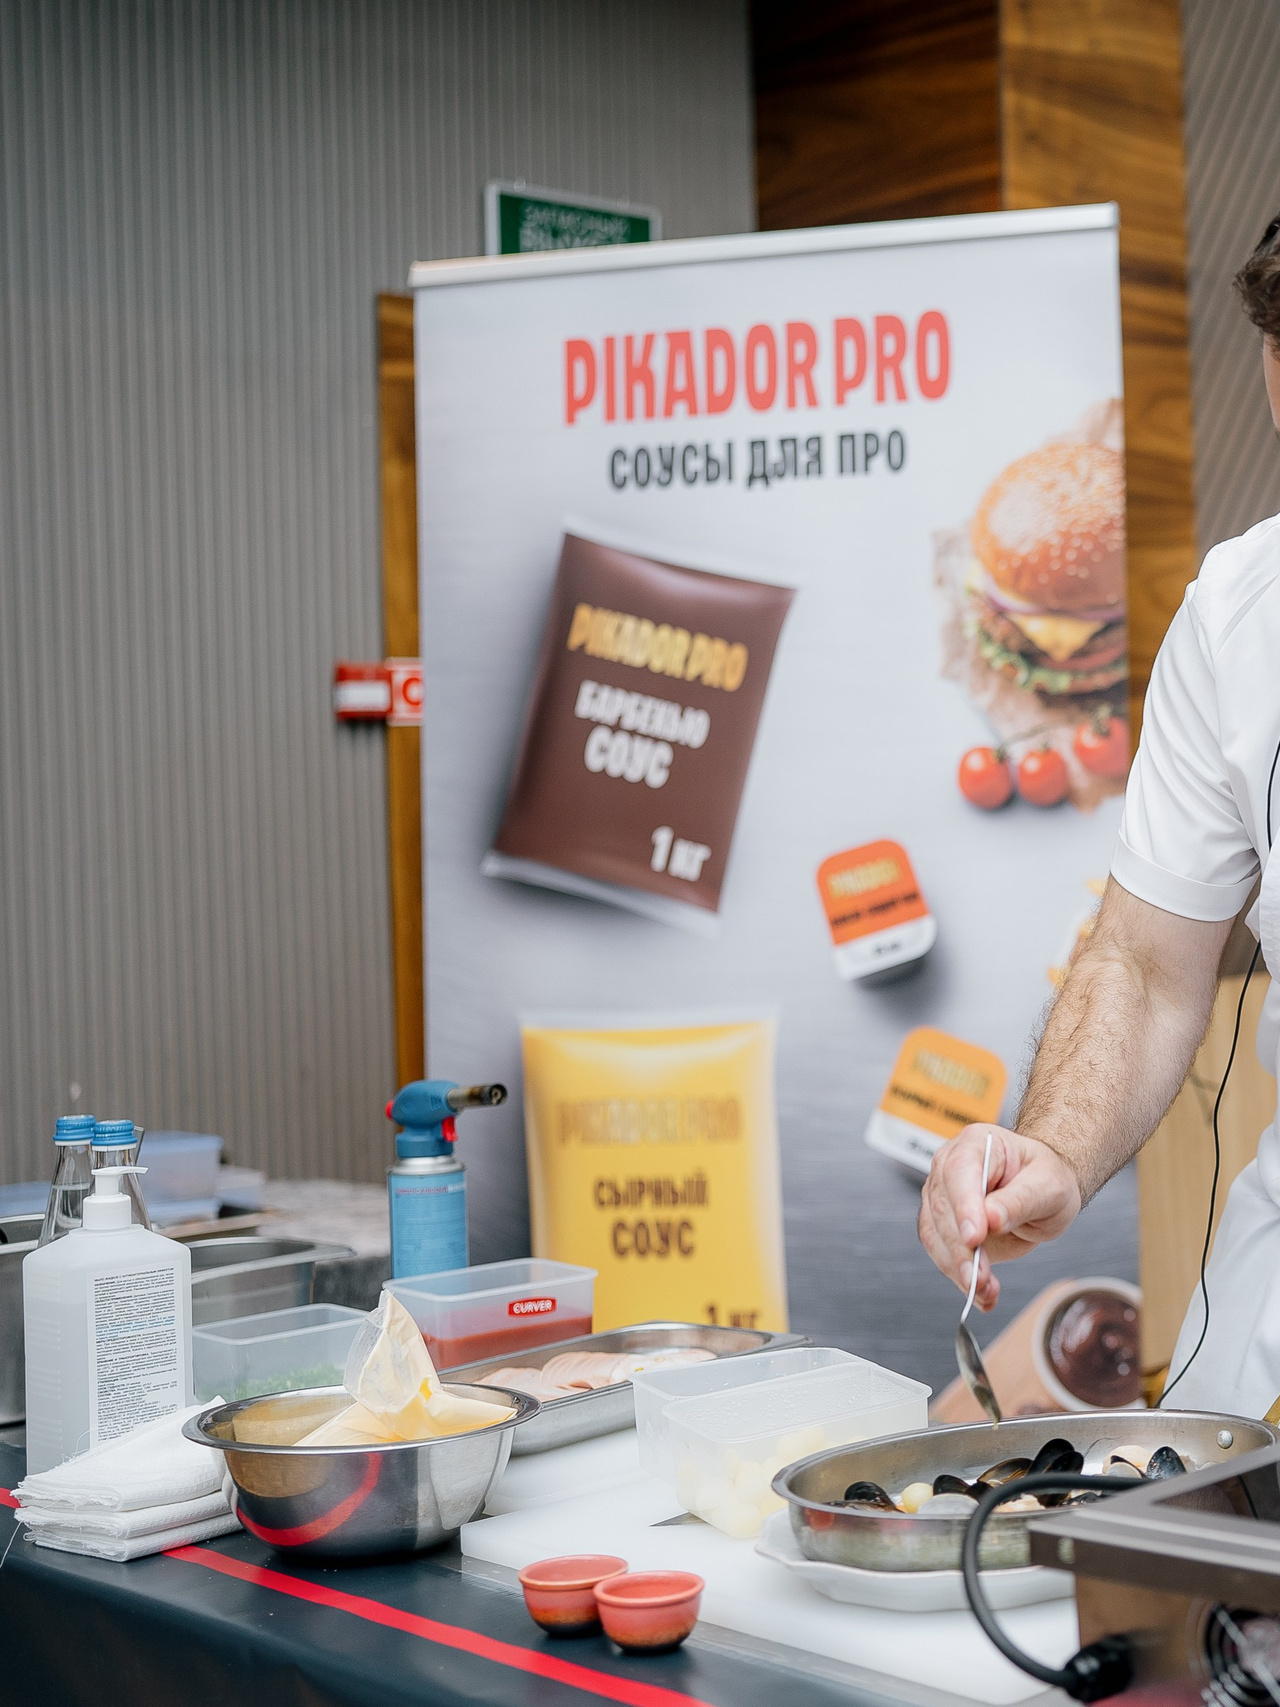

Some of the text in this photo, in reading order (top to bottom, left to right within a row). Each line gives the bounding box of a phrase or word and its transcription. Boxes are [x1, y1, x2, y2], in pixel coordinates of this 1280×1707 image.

[564, 309, 951, 427] PIKADOR PRO
[609, 428, 906, 490] СОУСЫ ДЛЯ ПРО
[584, 725, 673, 788] СОУС
[651, 825, 674, 872] 1
[594, 1167, 708, 1208] СЫРНЫЙ
[612, 1219, 695, 1259] СОУС
[513, 1299, 553, 1314] CURVER
